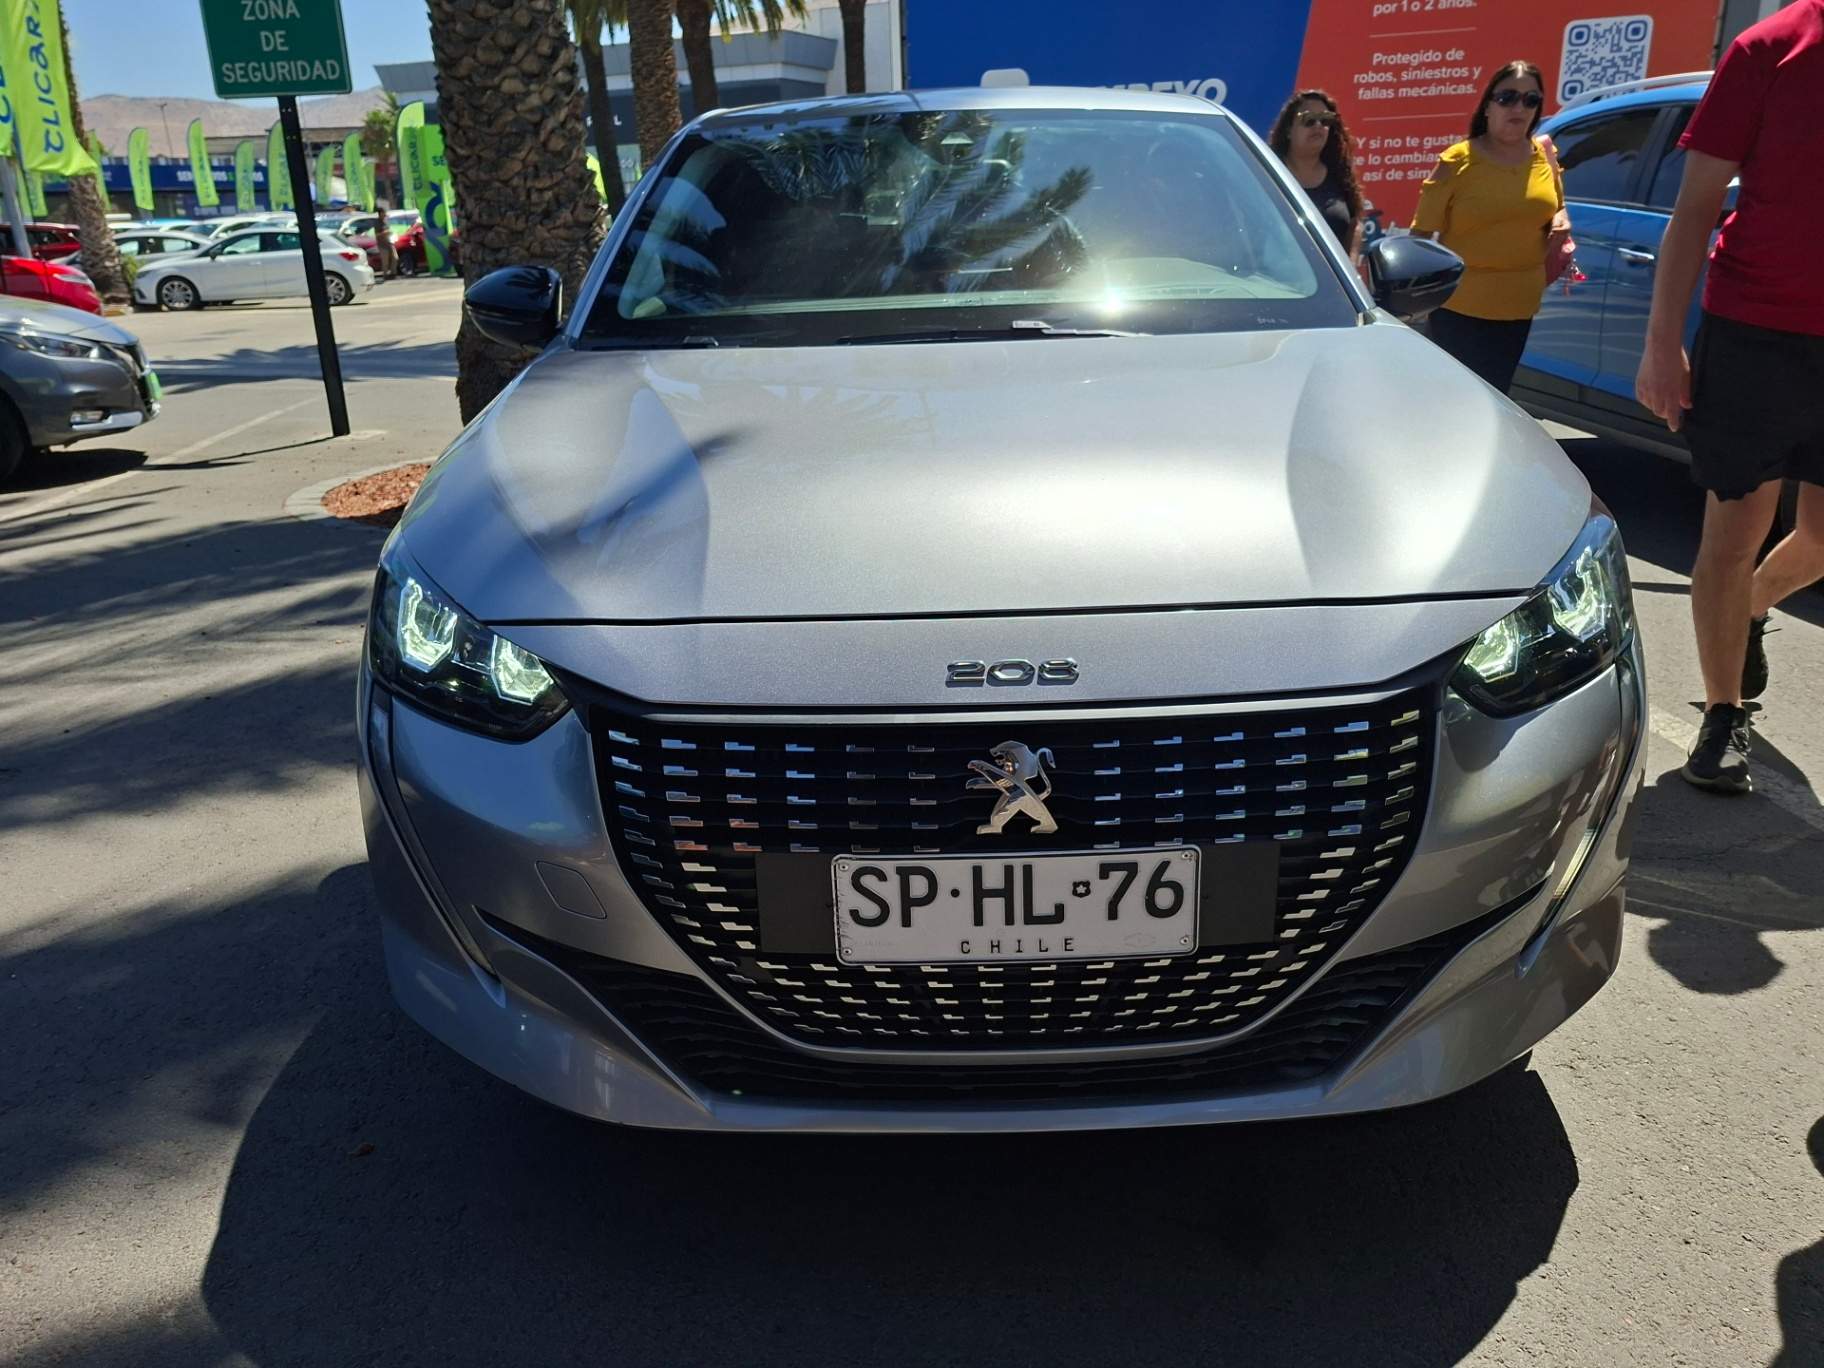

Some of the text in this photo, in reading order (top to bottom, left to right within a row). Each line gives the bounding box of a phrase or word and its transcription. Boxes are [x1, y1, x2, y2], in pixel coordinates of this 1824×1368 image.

[241, 0, 300, 20] ZONA
[1373, 3, 1397, 16] por
[1402, 0, 1408, 11] 1
[1411, 1, 1420, 11] o
[1424, 0, 1434, 10] 2
[260, 30, 288, 51] DE
[1372, 48, 1465, 66] Protegido de
[222, 59, 340, 83] SEGURIDAD
[1354, 66, 1482, 83] robos, siniestros y
[1358, 82, 1477, 100] fallas mecánicas.
[1356, 137, 1366, 149] Y
[1369, 136, 1380, 149] si
[1384, 137, 1402, 148] no
[1406, 135, 1420, 147] te
[1368, 153, 1381, 165] lo
[1363, 168, 1382, 181] así
[1385, 168, 1404, 180] de
[945, 657, 1080, 688] 208
[960, 938, 1075, 954] CHILE
